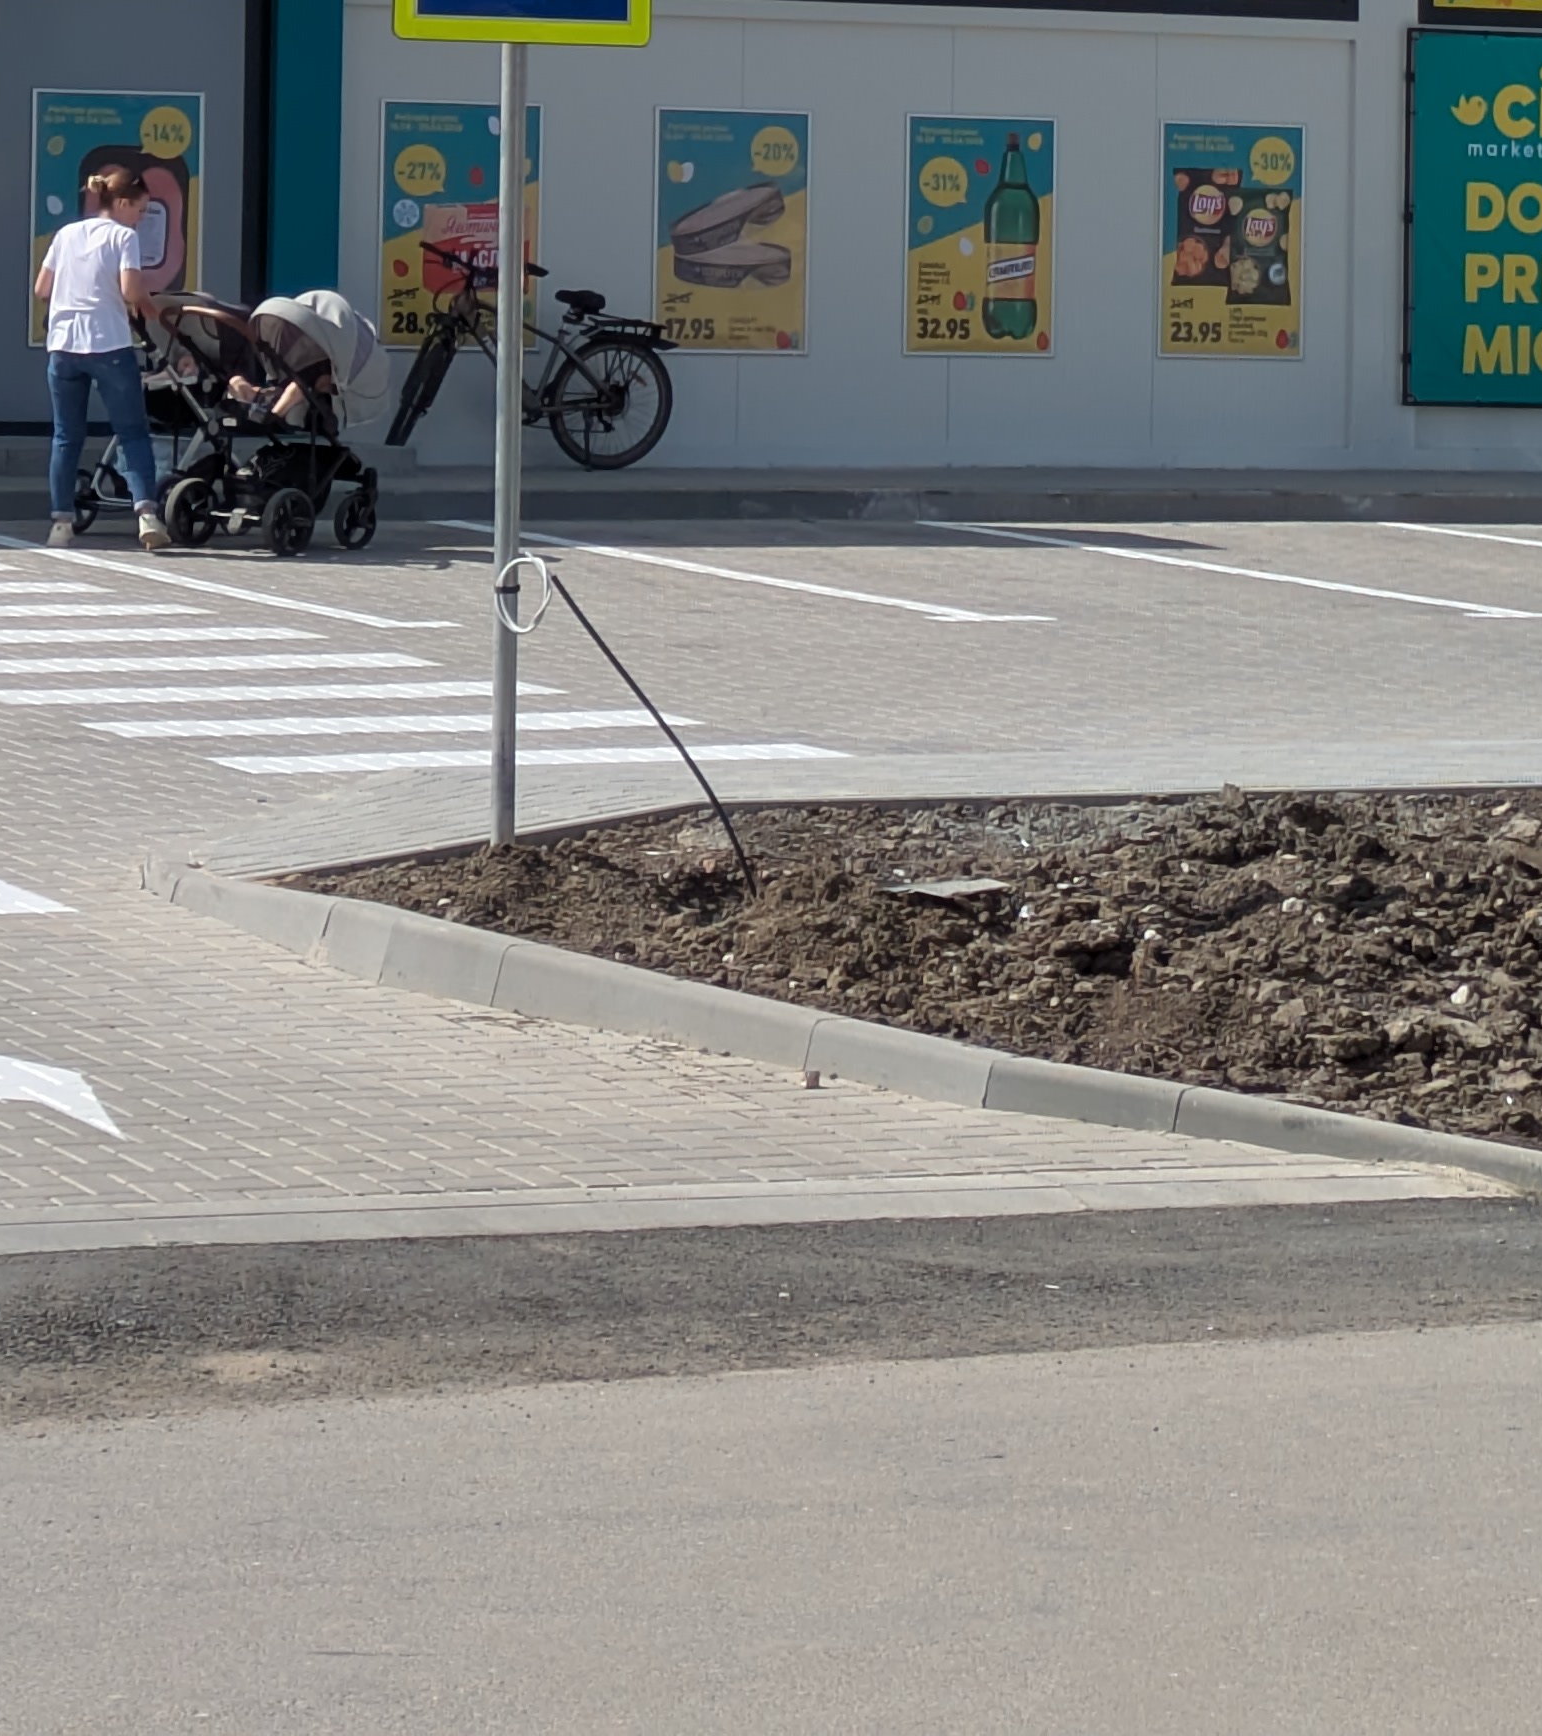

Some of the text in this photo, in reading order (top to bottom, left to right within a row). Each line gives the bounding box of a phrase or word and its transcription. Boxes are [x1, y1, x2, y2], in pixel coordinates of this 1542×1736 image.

[143, 123, 185, 144] -14%
[753, 143, 795, 161] -20%
[1253, 152, 1292, 172] -30%
[397, 162, 442, 182] -27%
[922, 173, 961, 192] -31%
[391, 311, 445, 334] 28.9
[665, 317, 715, 340] 17.95
[916, 317, 971, 340] 32.95
[1170, 321, 1222, 343] 23.95
